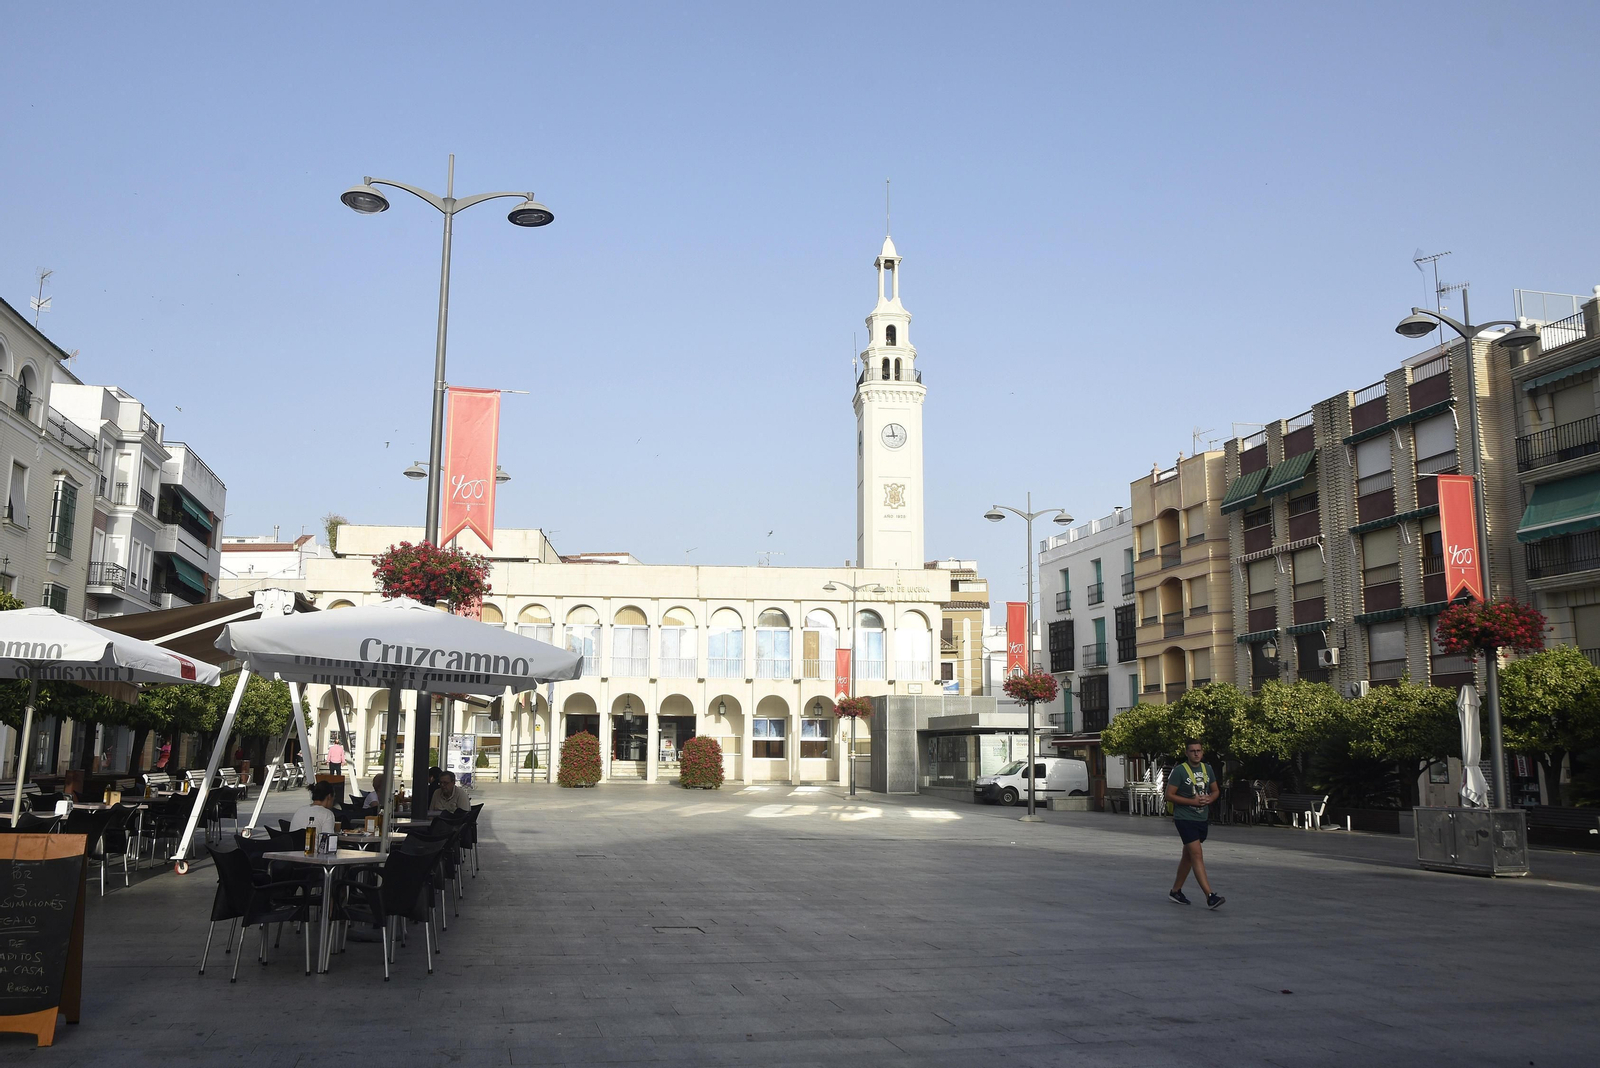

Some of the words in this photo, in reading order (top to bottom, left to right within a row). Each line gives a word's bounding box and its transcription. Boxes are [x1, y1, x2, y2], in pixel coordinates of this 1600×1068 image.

[451, 474, 489, 500] 400
[1448, 544, 1474, 565] 400
[1009, 641, 1025, 654] 400
[13, 883, 28, 898] 3
[13, 965, 45, 977] CASA
